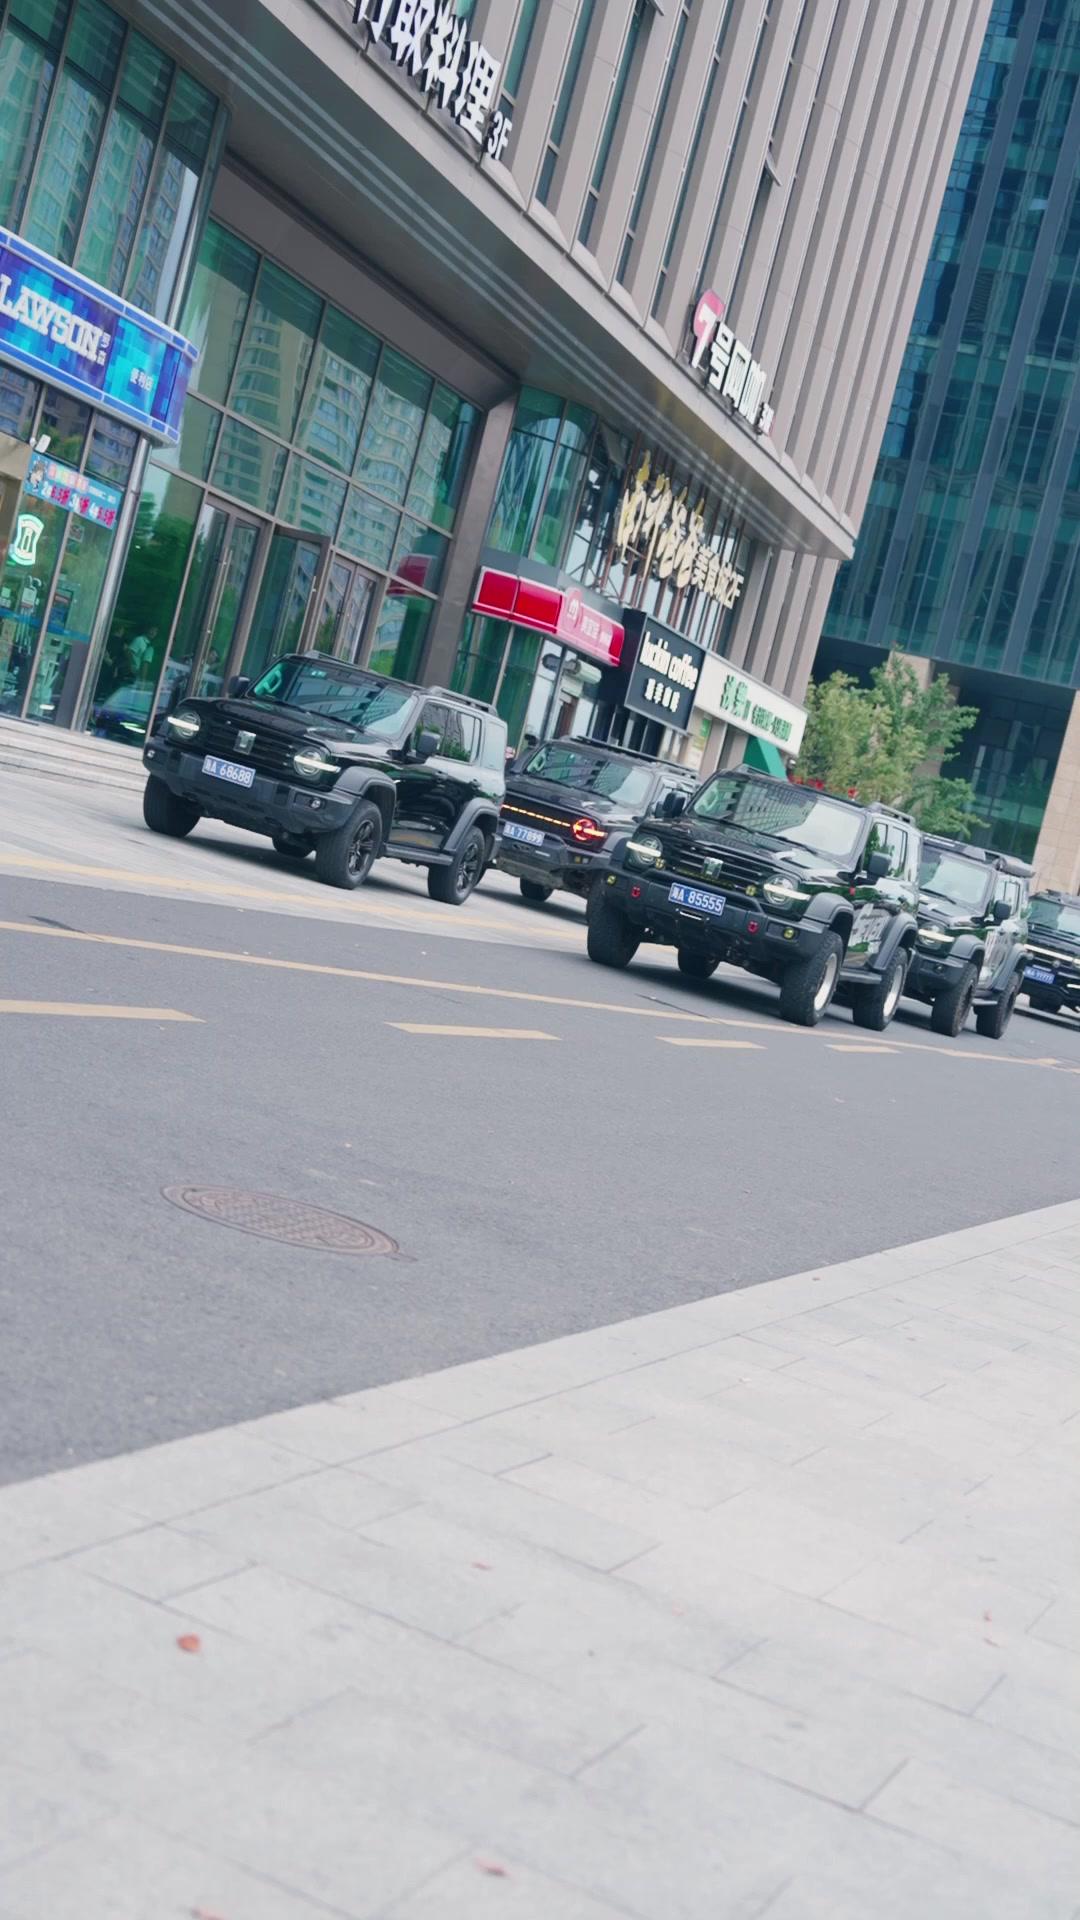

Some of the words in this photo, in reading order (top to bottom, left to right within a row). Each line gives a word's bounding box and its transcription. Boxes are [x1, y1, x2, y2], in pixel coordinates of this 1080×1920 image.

[487, 111, 513, 161] 3F
[0, 274, 104, 362] LAWSON
[640, 631, 671, 676] luckin
[667, 653, 699, 690] coffee
